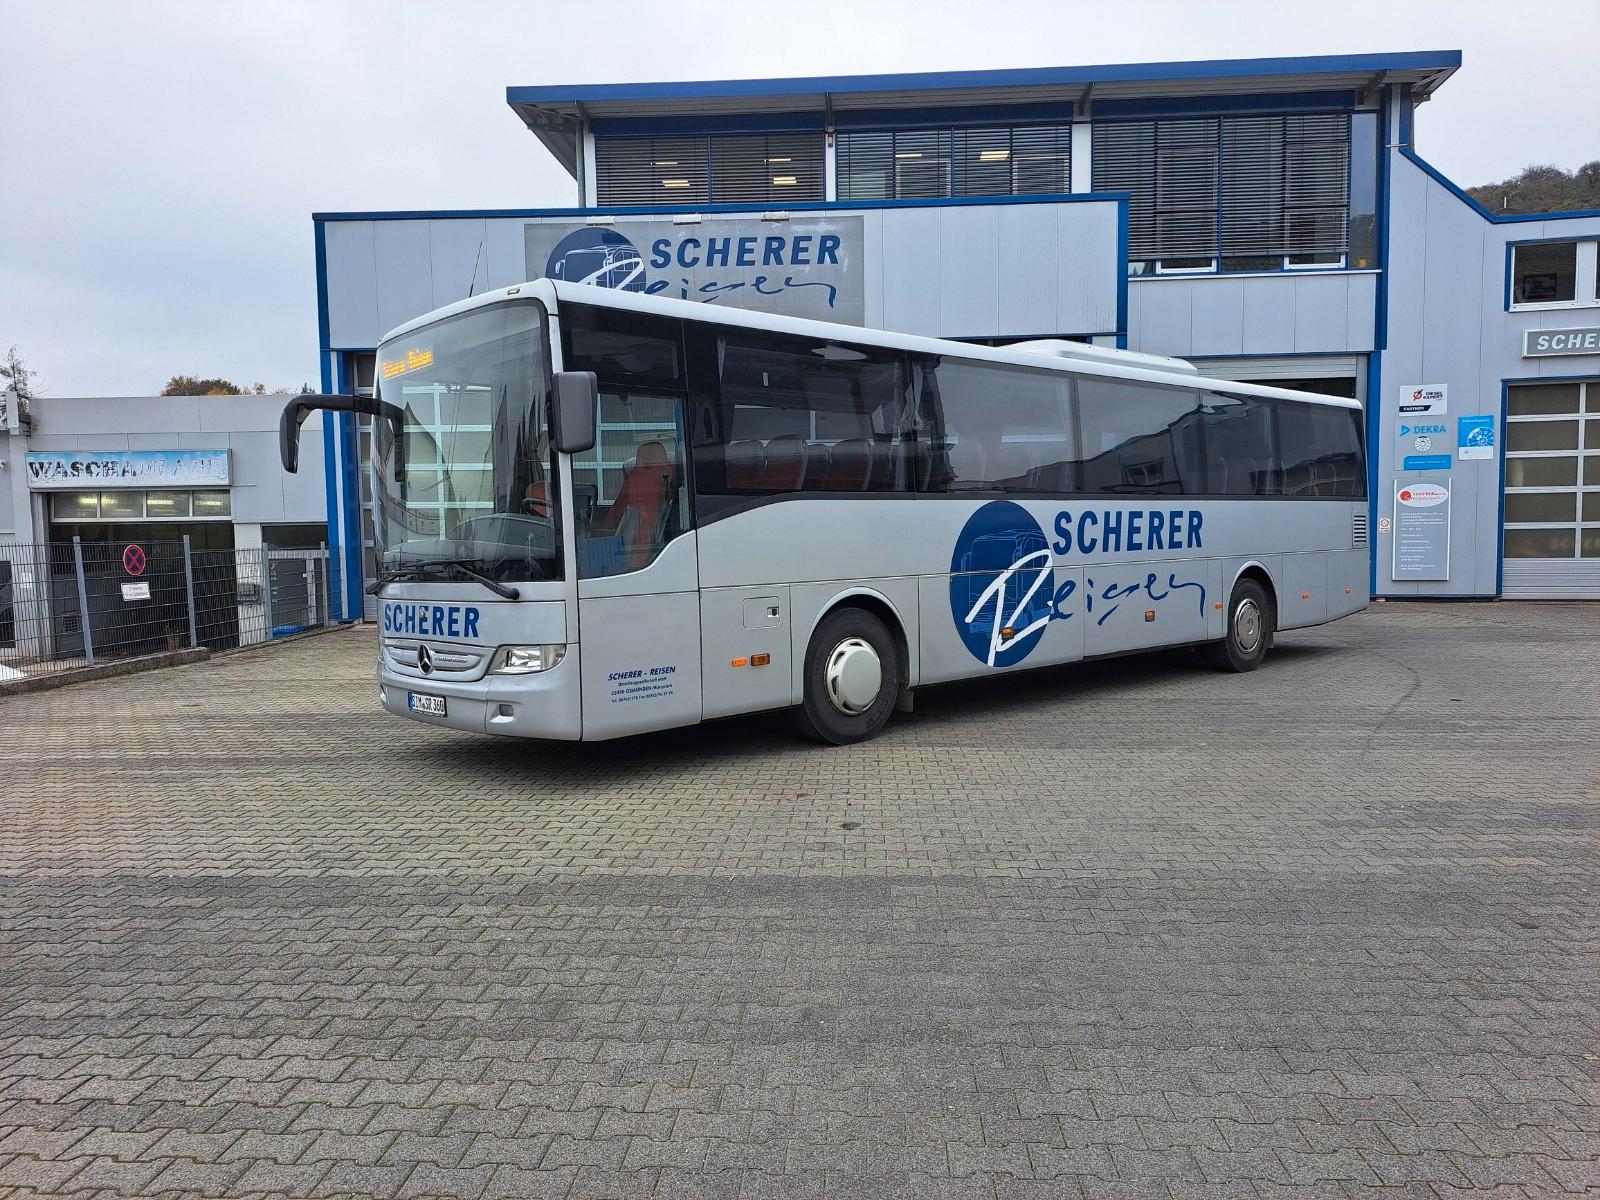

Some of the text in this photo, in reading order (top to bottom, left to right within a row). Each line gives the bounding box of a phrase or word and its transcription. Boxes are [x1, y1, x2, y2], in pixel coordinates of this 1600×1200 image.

[650, 234, 841, 269] SCHERER
[1536, 333, 1600, 351] SCHE
[1414, 425, 1447, 434] DEKRA
[1053, 510, 1203, 556] SCHERER
[384, 603, 480, 638] SCHERER
[964, 548, 1206, 667] Reisen
[608, 670, 642, 681] SCHERER
[649, 666, 676, 676] REISEN
